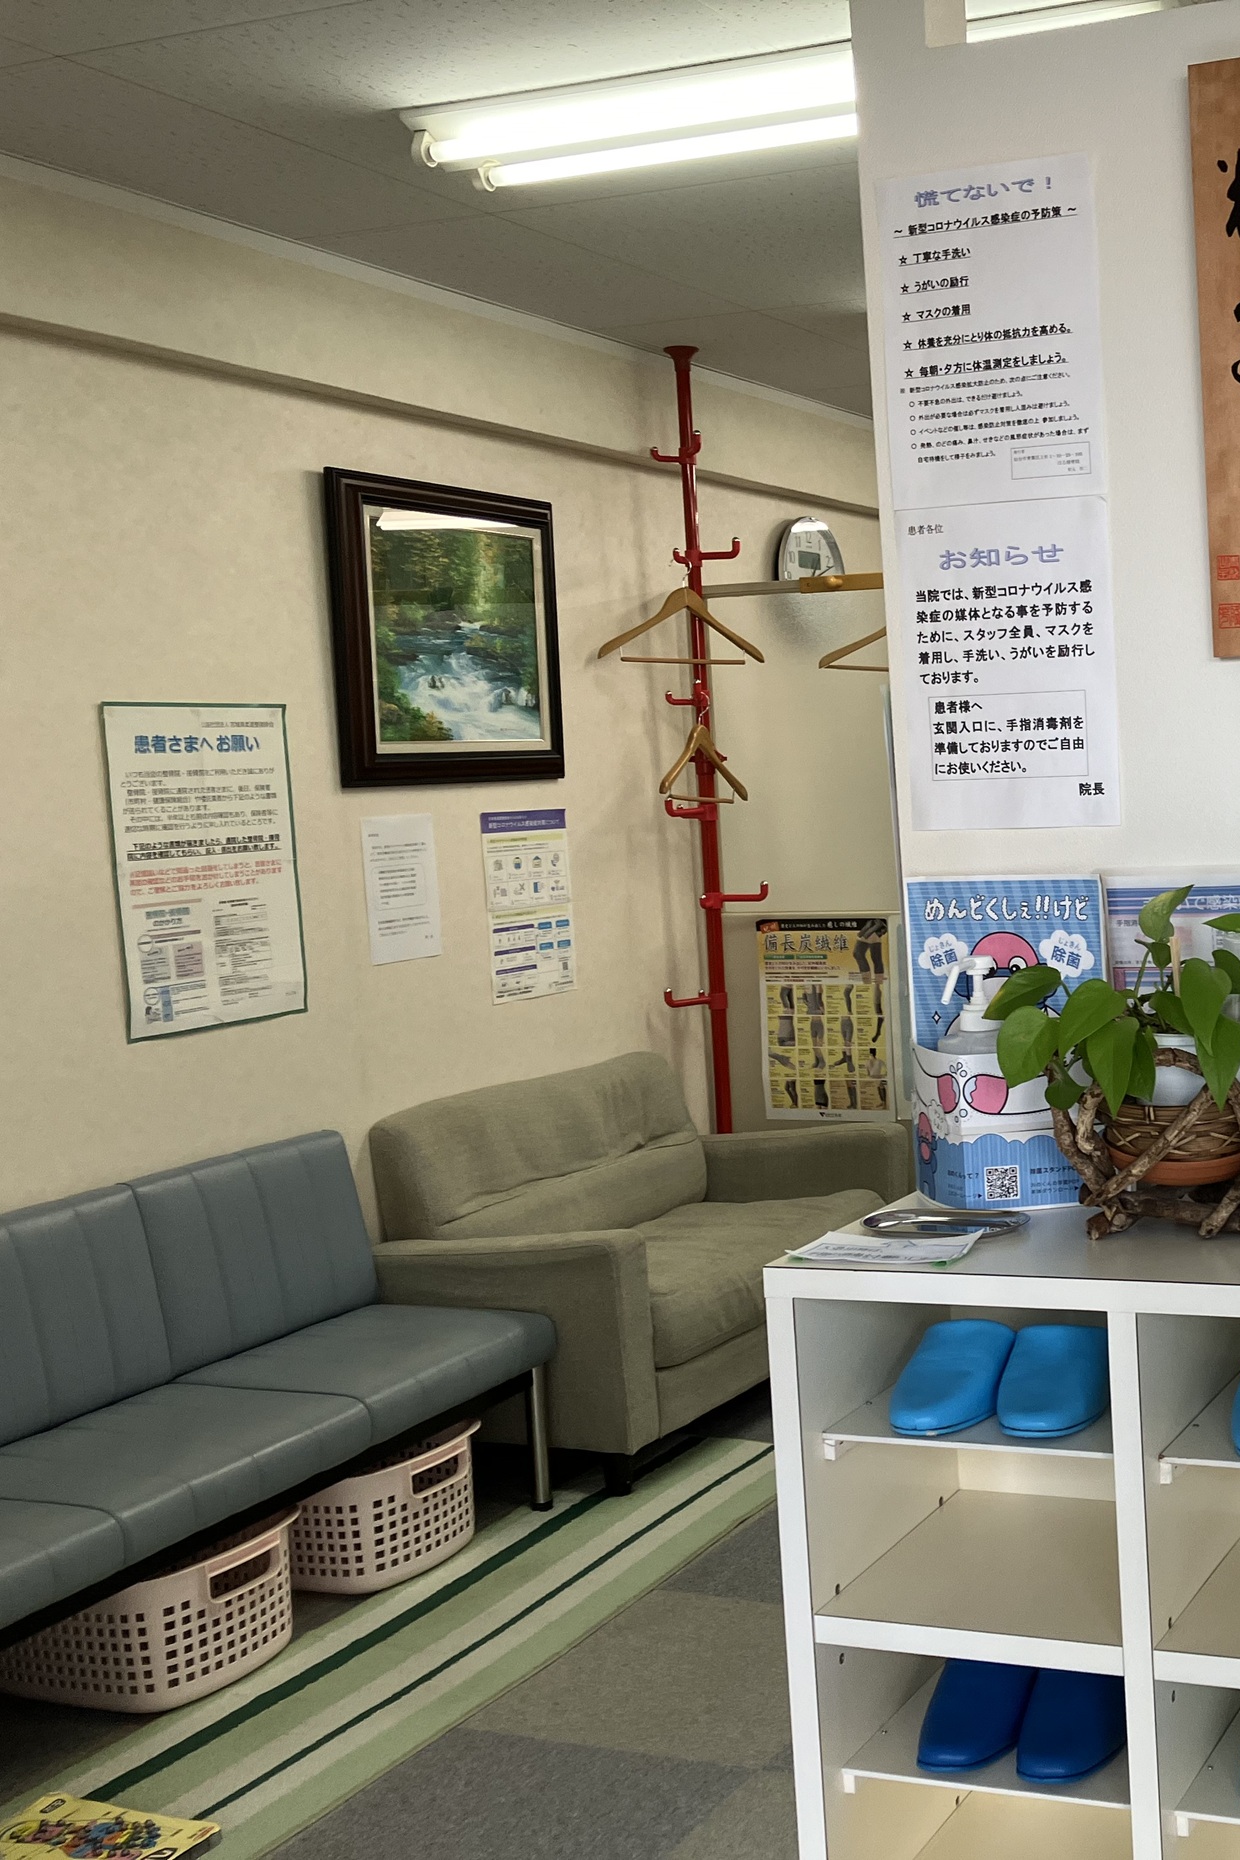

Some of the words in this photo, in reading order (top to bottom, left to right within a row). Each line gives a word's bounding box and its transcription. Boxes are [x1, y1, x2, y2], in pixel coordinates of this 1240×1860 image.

[912, 247, 971, 264] 丁寧な手洗い
[914, 276, 969, 293] うがいの励行
[916, 304, 971, 320] マスクの着用
[907, 523, 944, 536] 患者各位
[939, 544, 1064, 571] お知らせ
[916, 580, 1092, 603] 当院では、新型コロナウイルス感
[916, 601, 1093, 624] 染症の媒体となる事を予防する
[917, 622, 1094, 644] ために、スタッフ全員、マスクを
[918, 644, 1095, 665] 着用し、手洗い、うがいを励行し
[920, 671, 979, 685] ております。
[934, 700, 983, 715] 患者様へ
[933, 716, 1084, 735] 玄関入口に、手指消毒剤を
[134, 735, 260, 754] 患者さまへお願い
[934, 737, 1085, 755] 準備しておりますのでご自由
[935, 760, 1028, 776] にお使いください。
[1078, 782, 1105, 796] 院長
[764, 933, 849, 952] 備長炭繊維
[928, 940, 952, 952] じょきん
[1058, 936, 1081, 951] じょきん
[930, 948, 958, 969] 除菌
[1051, 945, 1082, 970] 除菌
